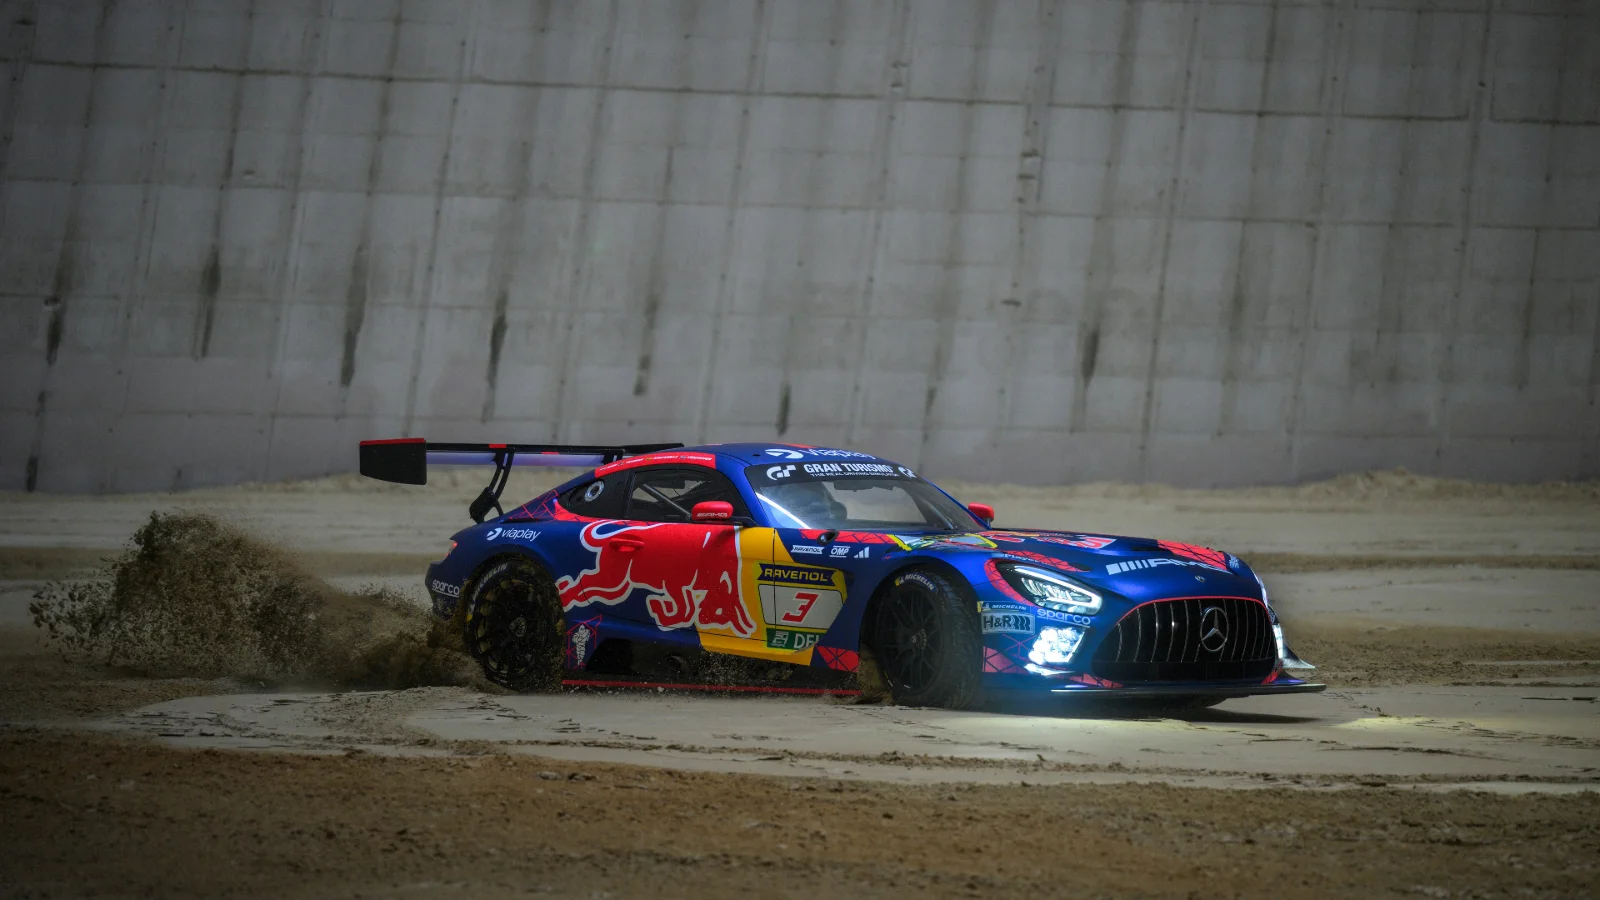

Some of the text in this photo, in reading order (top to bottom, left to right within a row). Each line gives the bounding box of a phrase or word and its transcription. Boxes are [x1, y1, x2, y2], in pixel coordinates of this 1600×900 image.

[804, 463, 893, 473] GRAN TURISMO
[501, 527, 541, 541] viaplay
[830, 546, 850, 556] OMP
[764, 567, 829, 582] RAVENOL
[904, 573, 935, 591] MICHELIN
[432, 578, 460, 596] sparco
[781, 591, 820, 623] 3
[983, 614, 1012, 629] H&R
[1037, 608, 1091, 625] sparco
